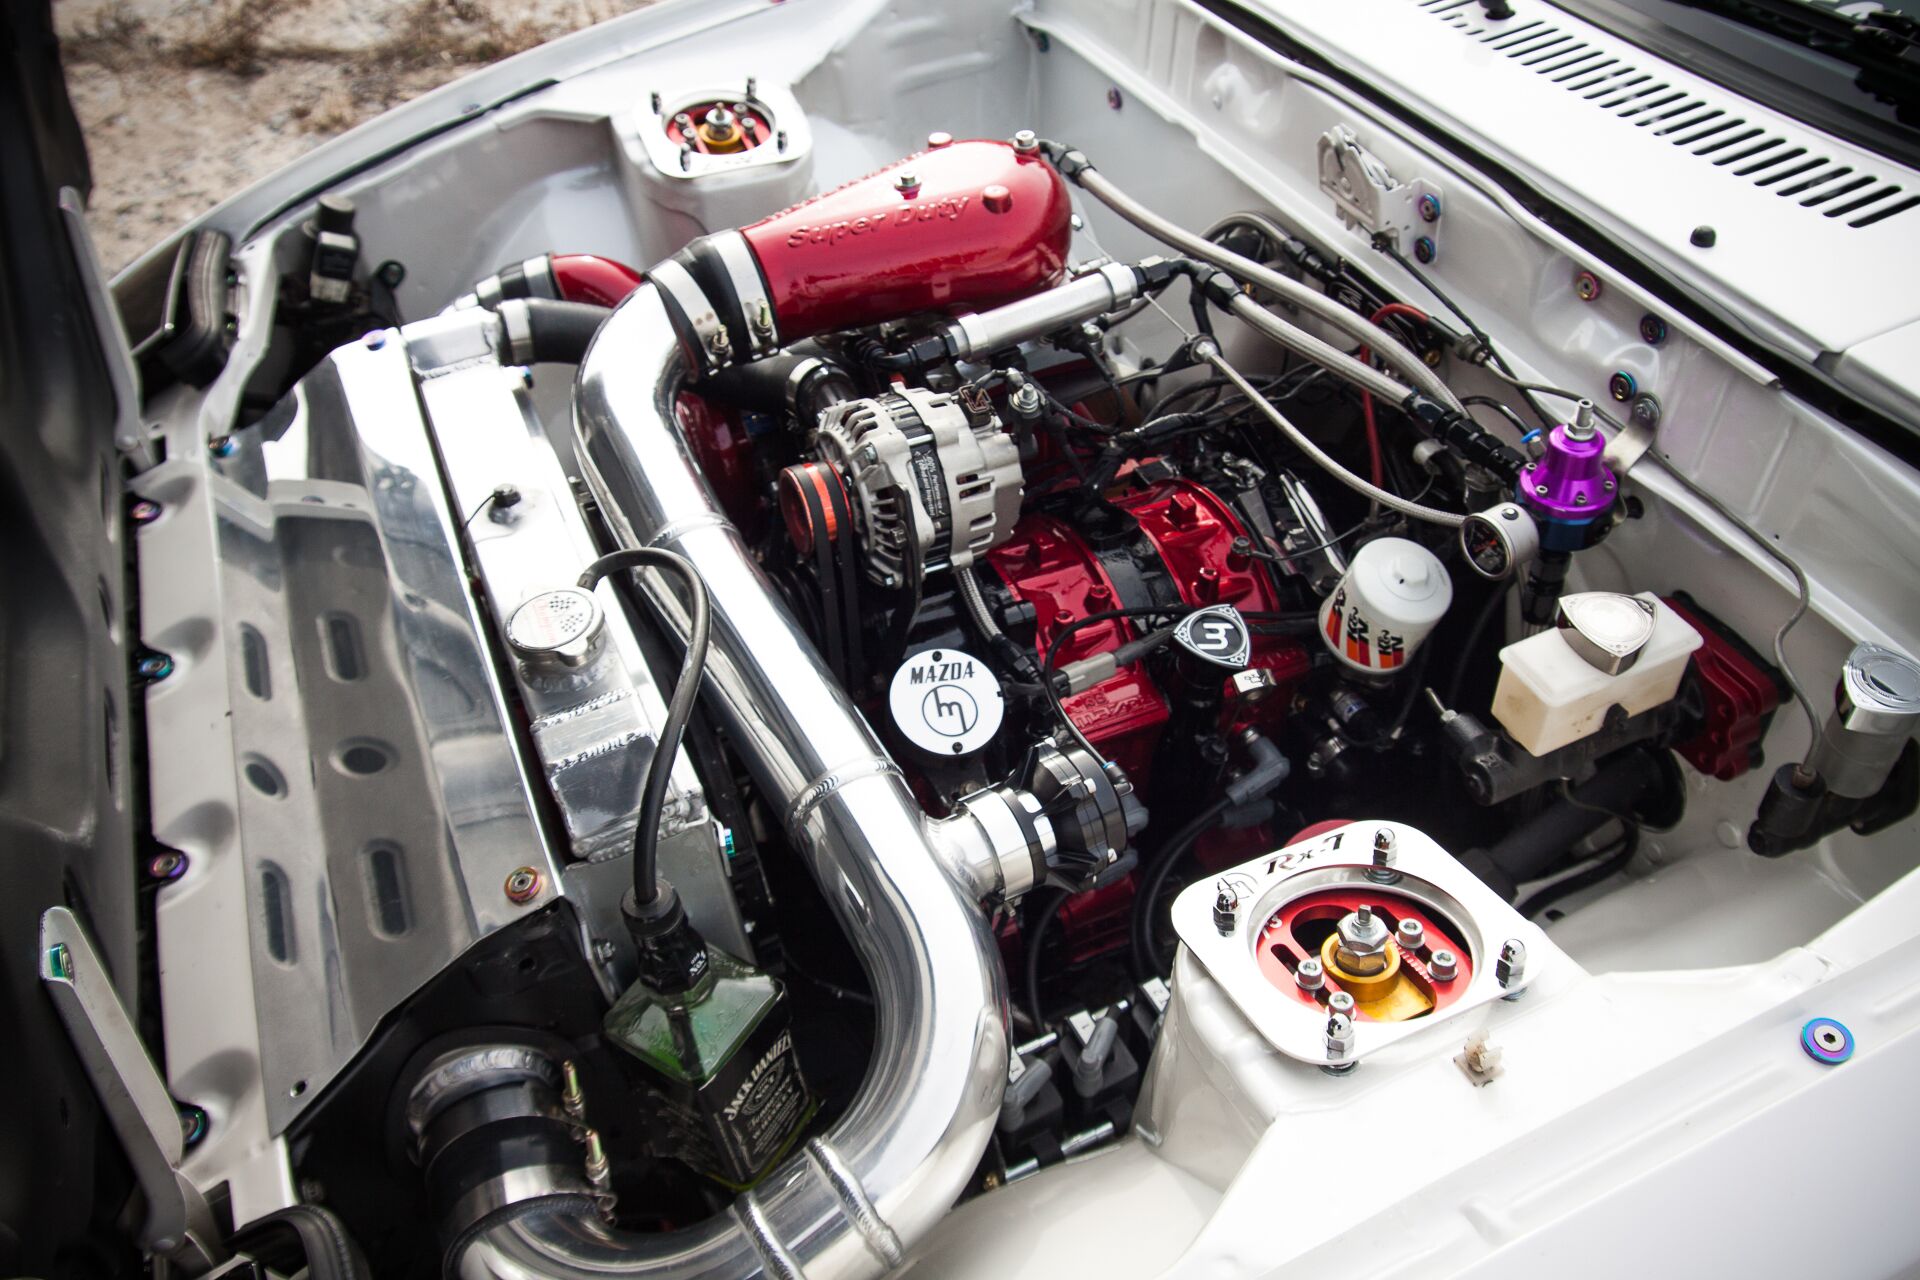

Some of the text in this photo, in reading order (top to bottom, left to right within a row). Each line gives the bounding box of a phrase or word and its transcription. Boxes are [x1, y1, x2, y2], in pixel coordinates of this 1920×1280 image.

[787, 195, 970, 248] Super Duty
[910, 661, 976, 685] MAZDA
[723, 1079, 754, 1121] JACK
